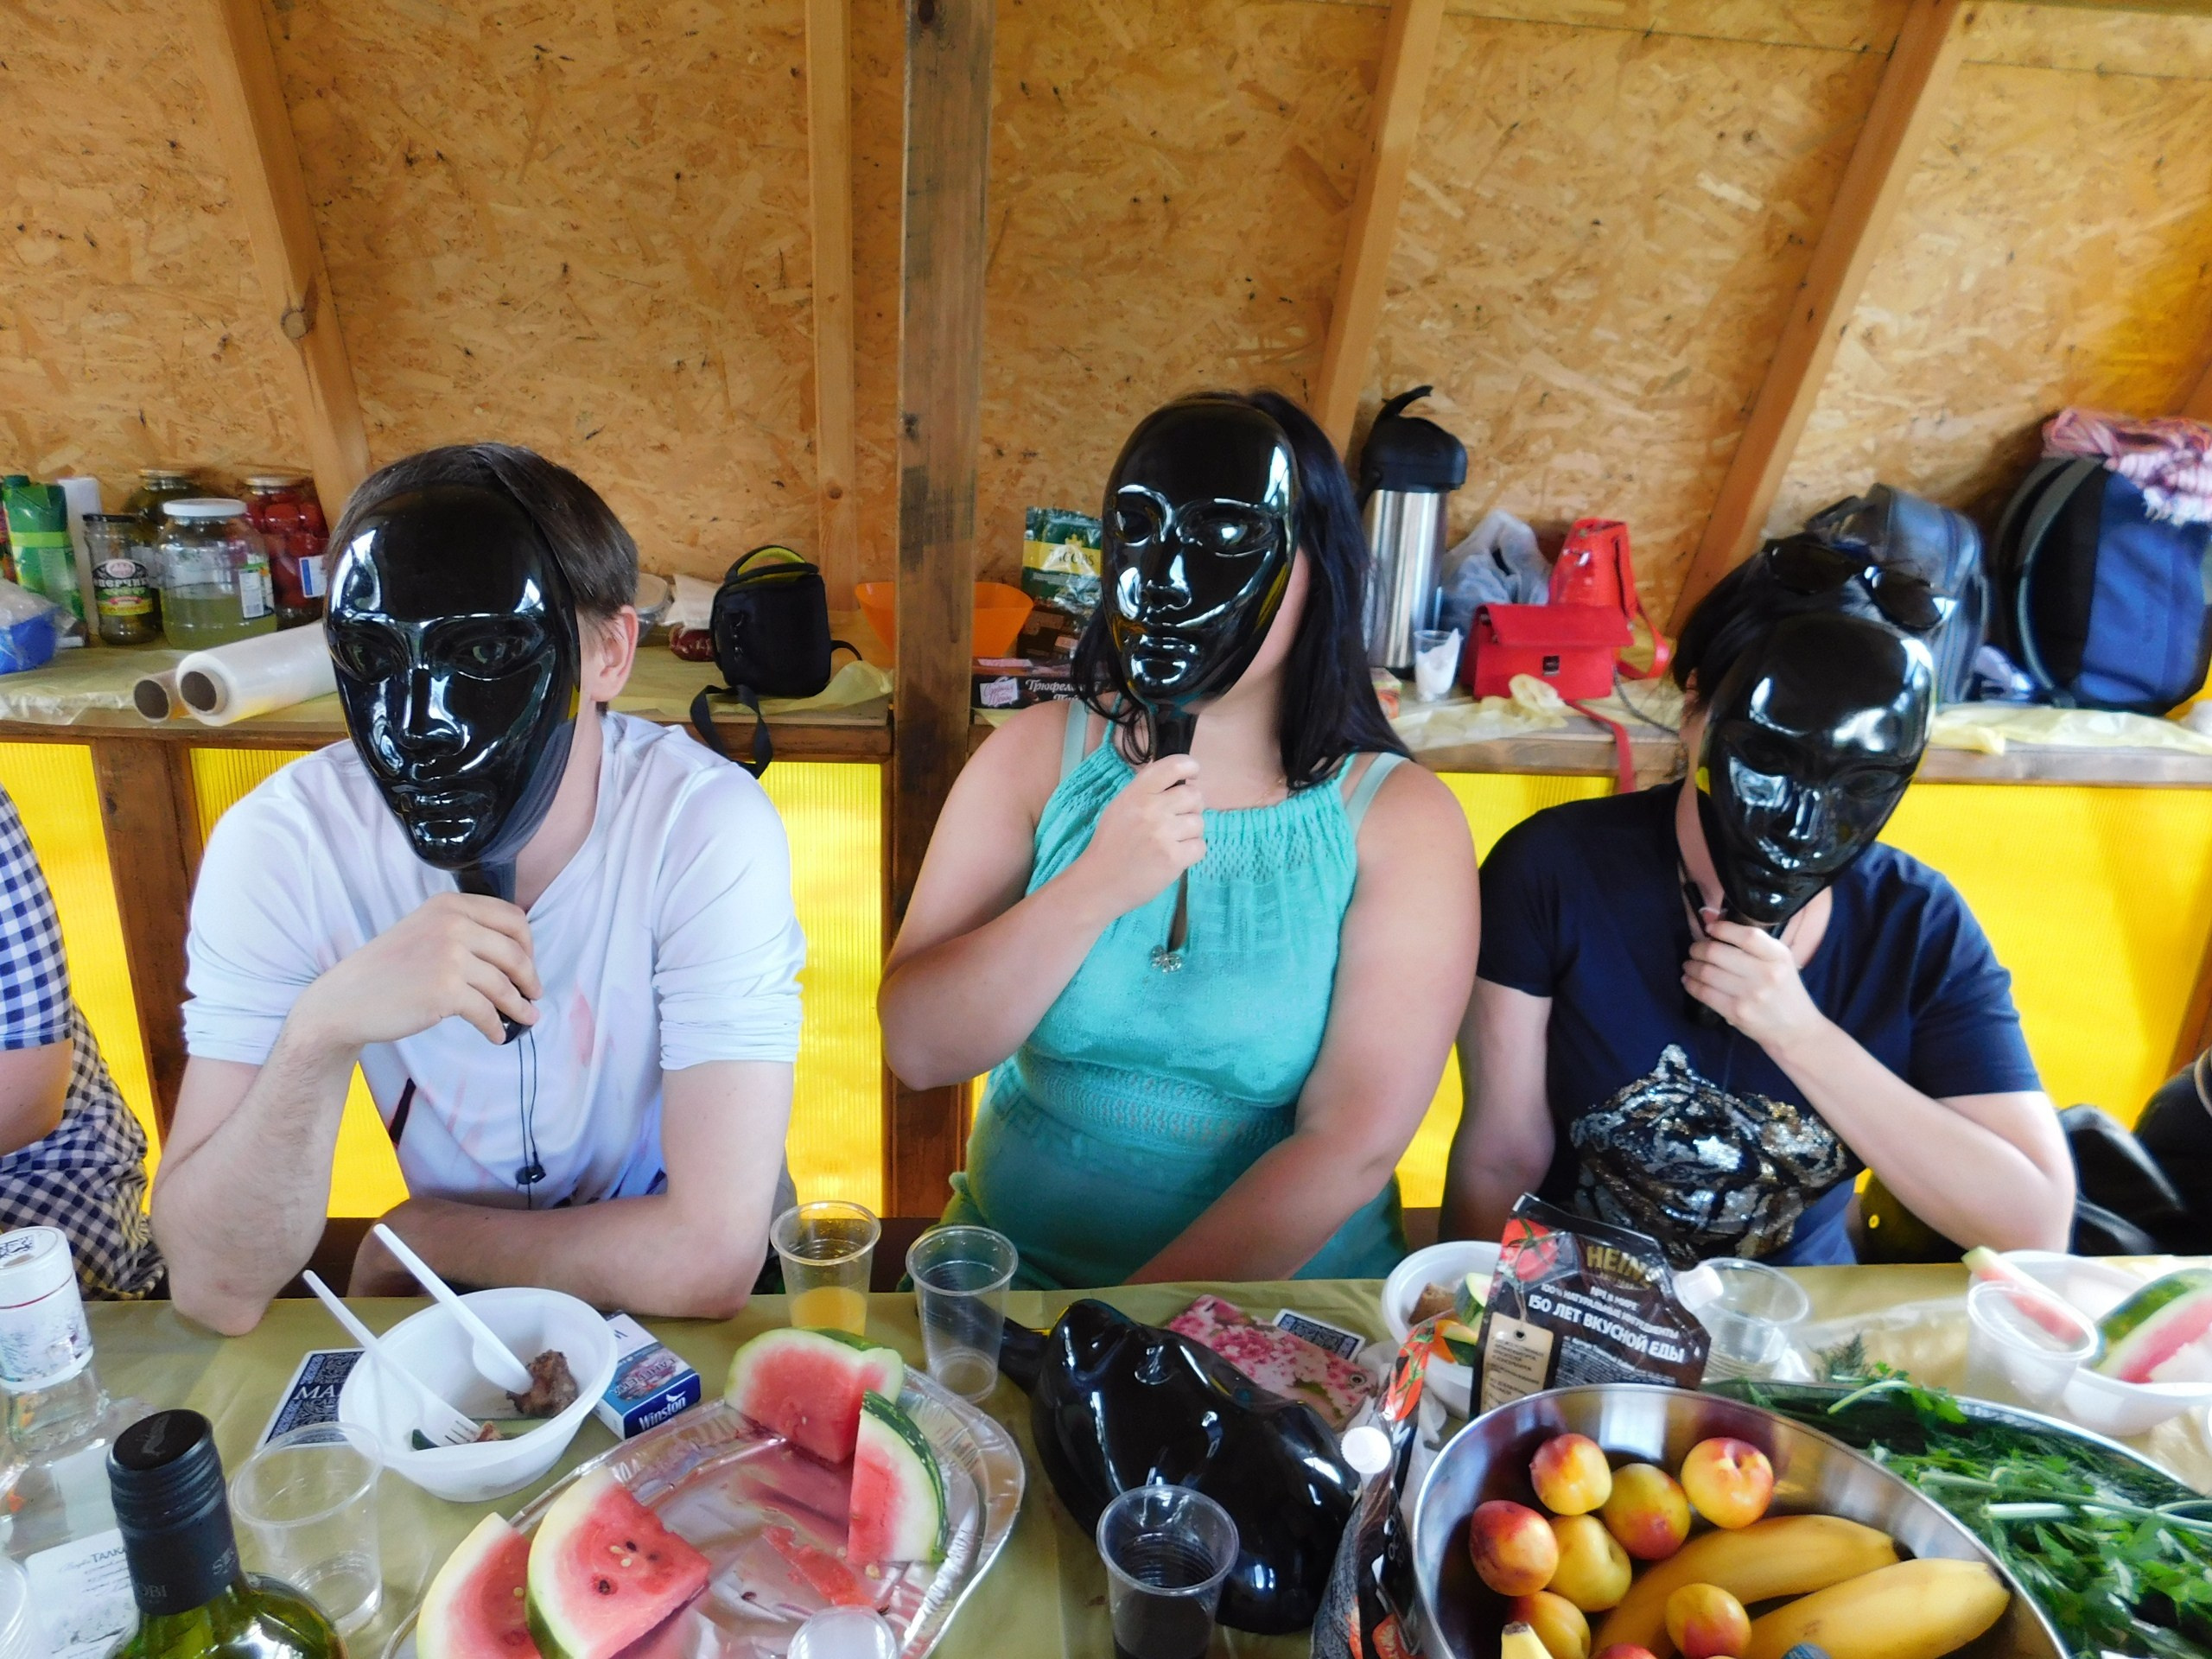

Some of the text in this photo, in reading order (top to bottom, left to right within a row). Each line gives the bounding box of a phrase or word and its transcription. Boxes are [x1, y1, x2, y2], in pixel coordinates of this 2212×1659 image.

[1049, 550, 1095, 566] COBS
[1528, 1294, 1685, 1363] 150 ЛЕТ ВКУСНОЙ ЕДЫ
[639, 1396, 686, 1431] Winston
[91, 1547, 127, 1563] ТАЛК
